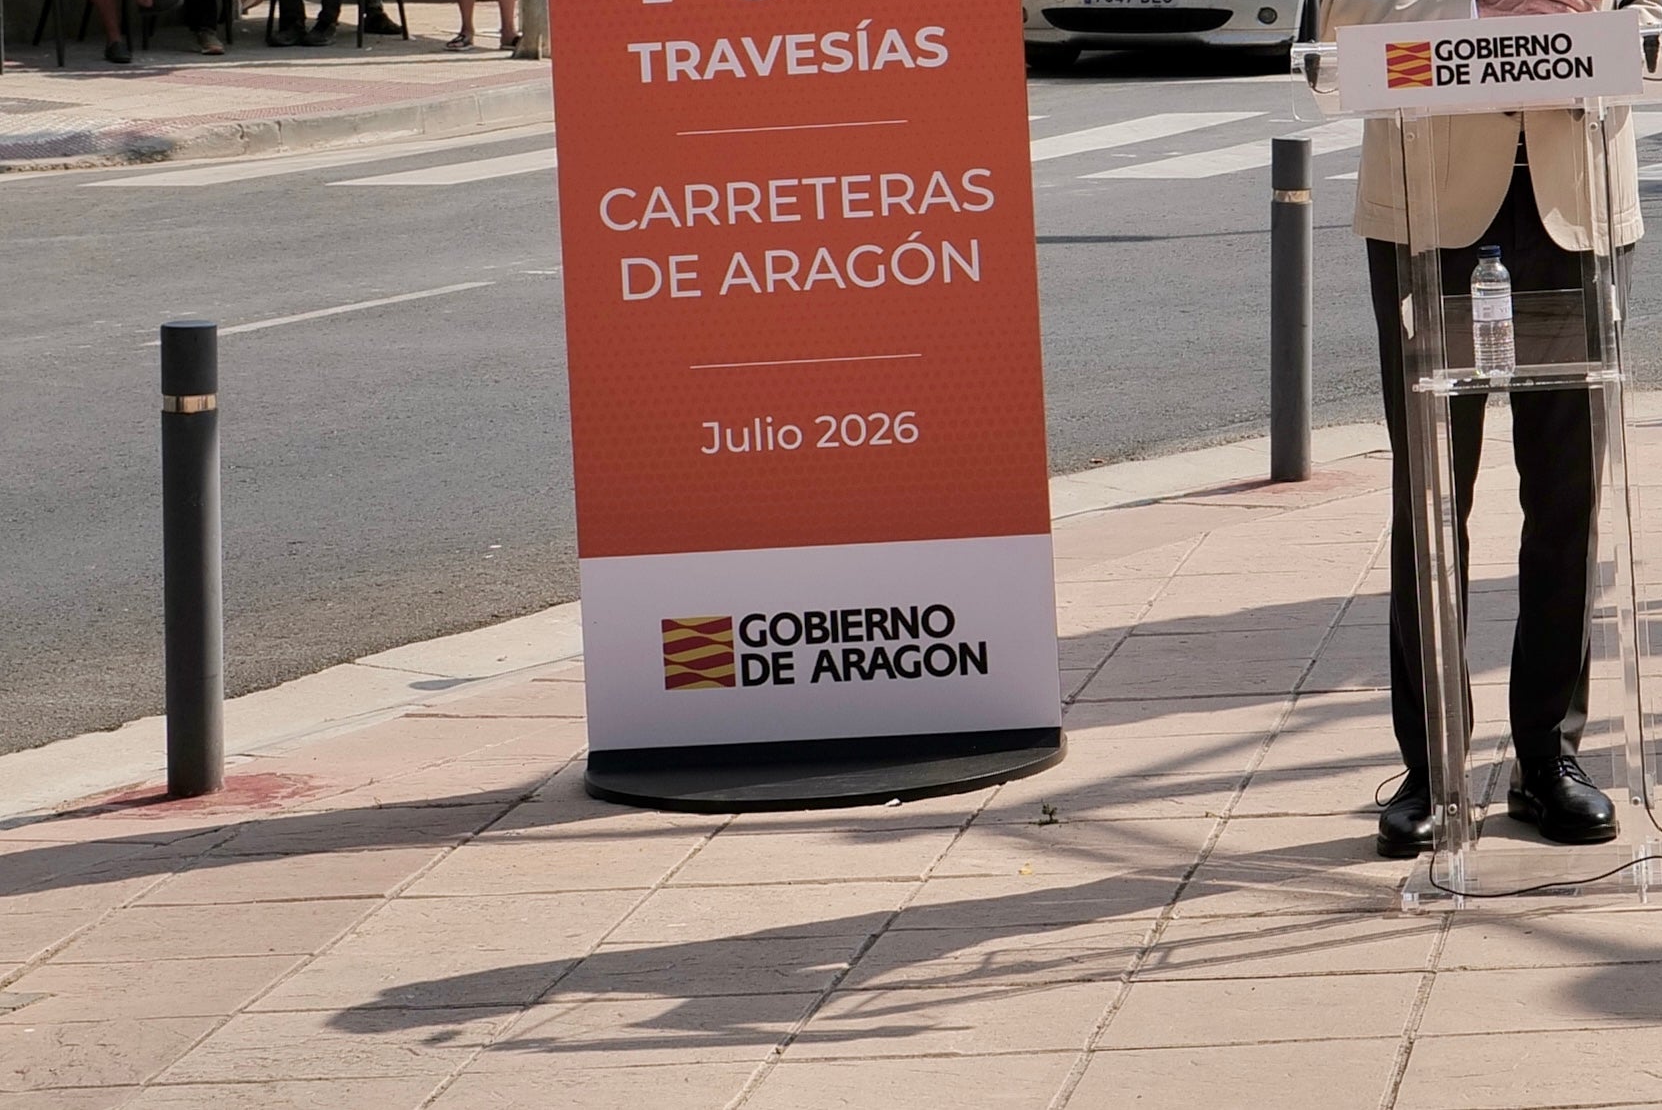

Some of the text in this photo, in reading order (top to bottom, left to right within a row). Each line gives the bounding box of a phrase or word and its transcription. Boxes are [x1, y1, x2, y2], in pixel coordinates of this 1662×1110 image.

[627, 18, 950, 84] TRAVESÍAS
[1434, 32, 1573, 62] GOBIERNO
[1436, 56, 1594, 87] DE ARAGON
[598, 167, 996, 232] CARRETERAS
[620, 231, 982, 302] DE ARAGÓN
[701, 410, 920, 455] Julio 2026
[738, 604, 957, 649] GOBIERNO
[740, 639, 990, 688] DE ARAGON
